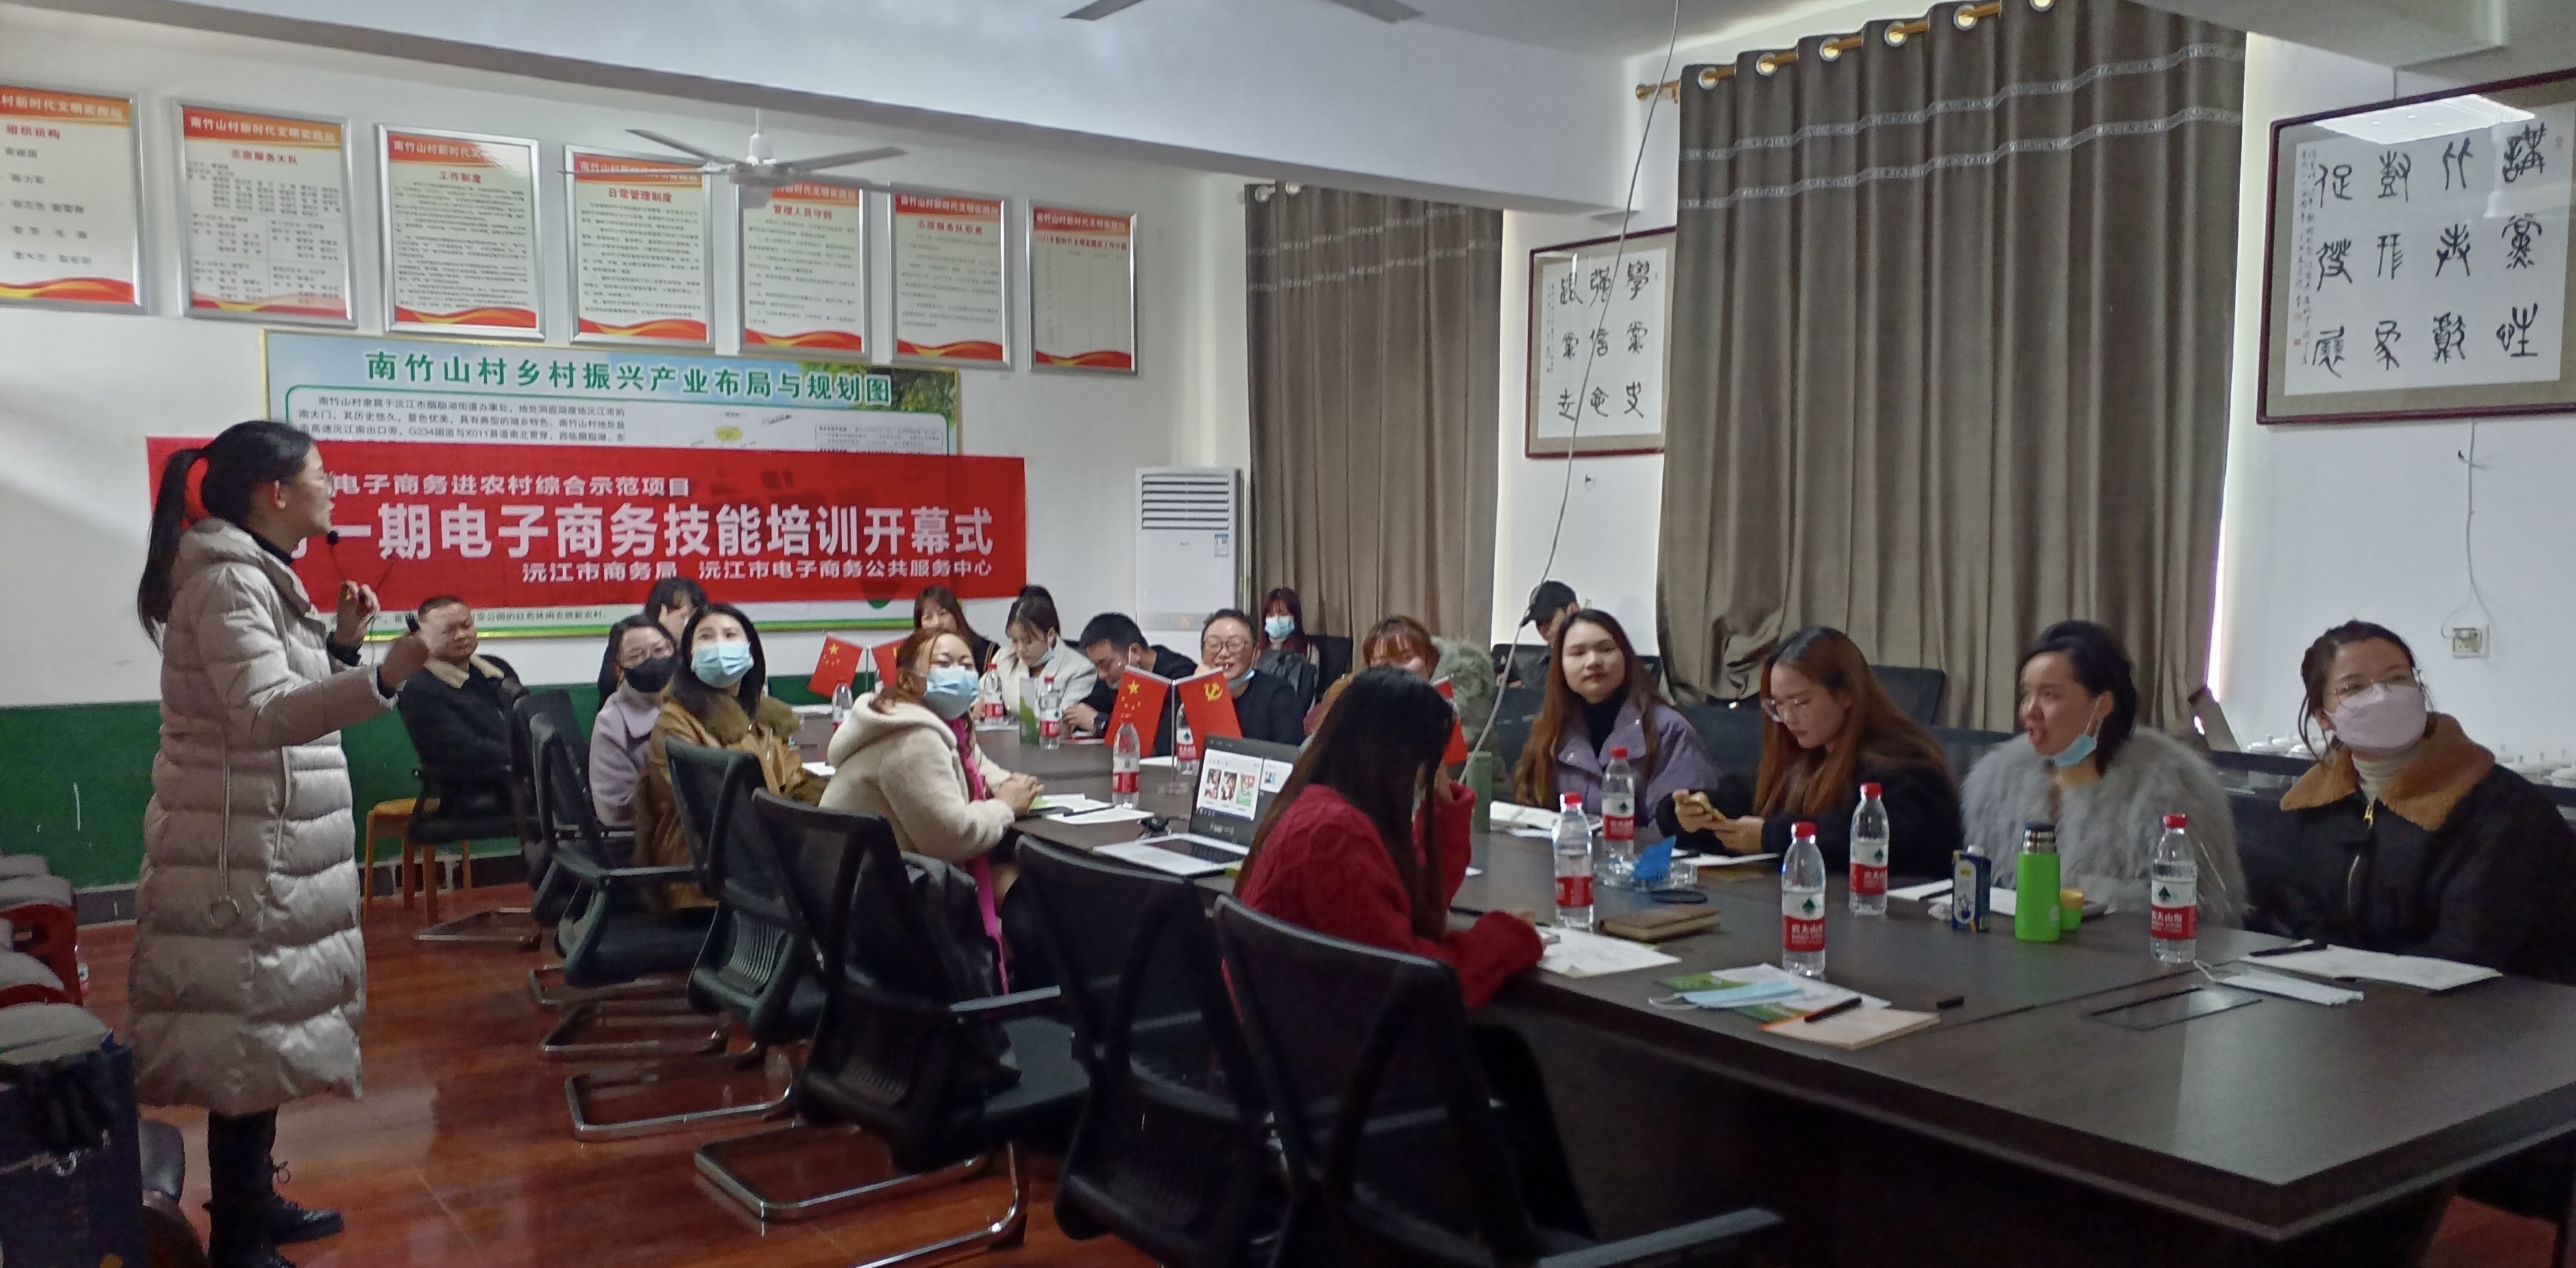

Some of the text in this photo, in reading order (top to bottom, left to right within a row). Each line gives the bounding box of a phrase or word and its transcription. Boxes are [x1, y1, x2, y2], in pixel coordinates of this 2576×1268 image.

[439, 170, 482, 184] 工作制度
[608, 187, 672, 203] 日常管理制度
[774, 203, 832, 220] 管理人员守则
[365, 350, 890, 404] 南竹山村乡村振兴产业布局与规划图
[332, 472, 689, 498] 电子商务进农村综合示范项目
[290, 502, 994, 560] 一期电子商务技能培训开幕式
[522, 558, 993, 583] 沅江市商务局 沅江市电子商务公共服务中心
